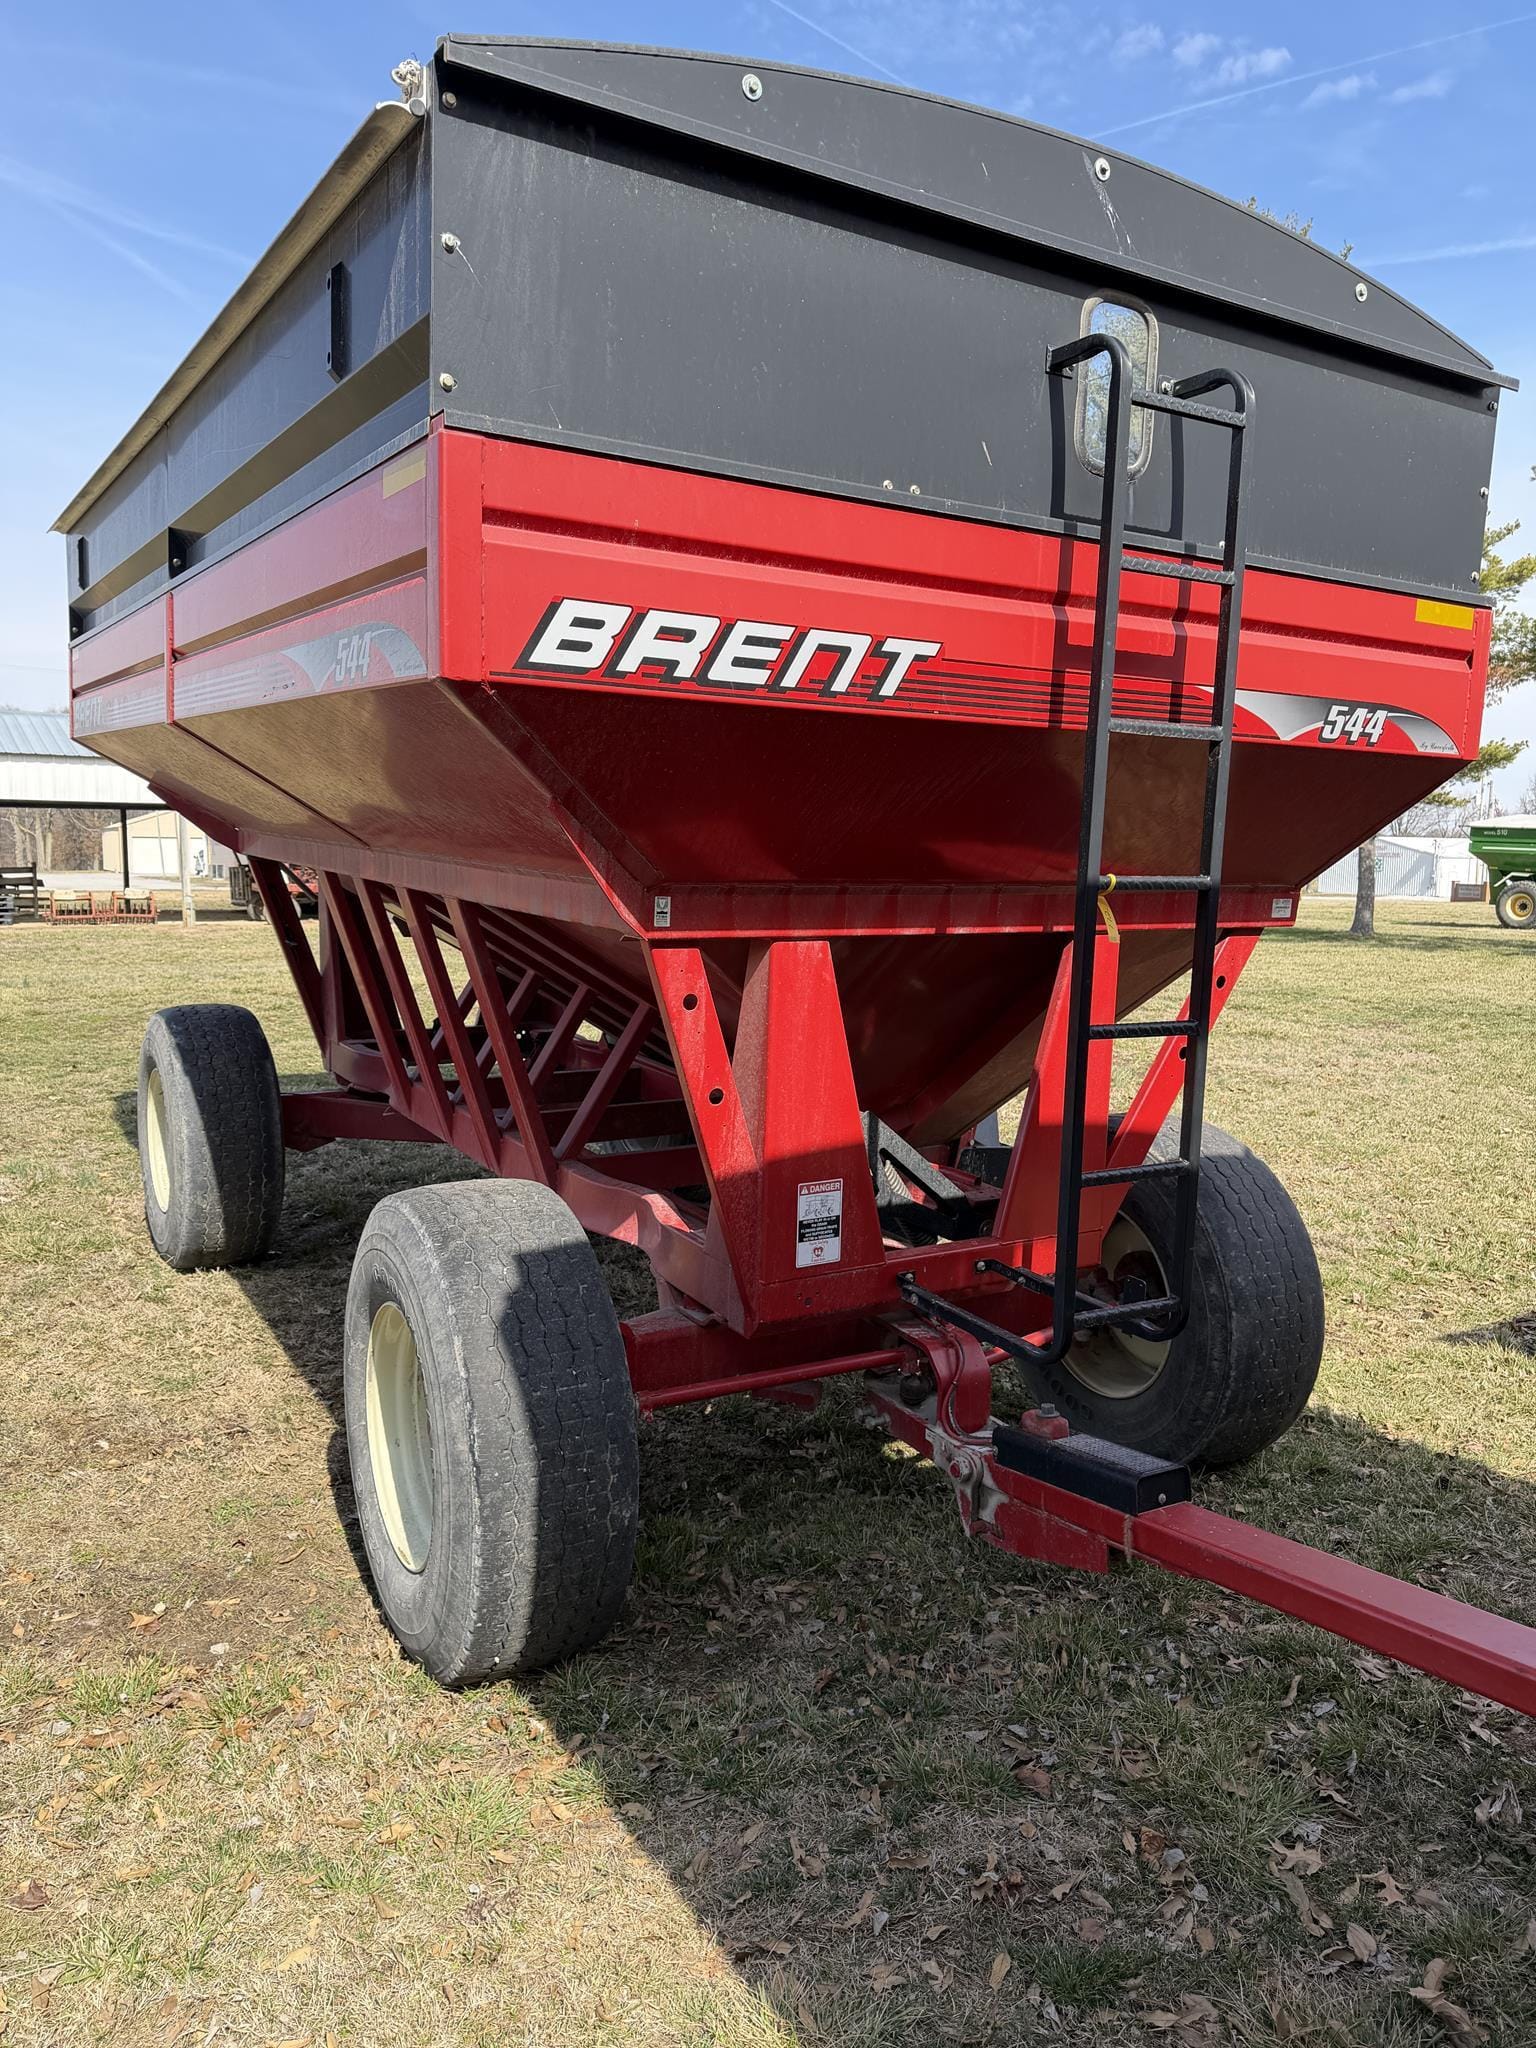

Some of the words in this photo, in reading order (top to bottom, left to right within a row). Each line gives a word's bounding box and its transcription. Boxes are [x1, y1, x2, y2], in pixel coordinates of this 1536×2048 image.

[335, 631, 371, 682] 544
[513, 596, 944, 701] BRENT
[1319, 704, 1388, 746] 544
[809, 1182, 841, 1193] DANGER
